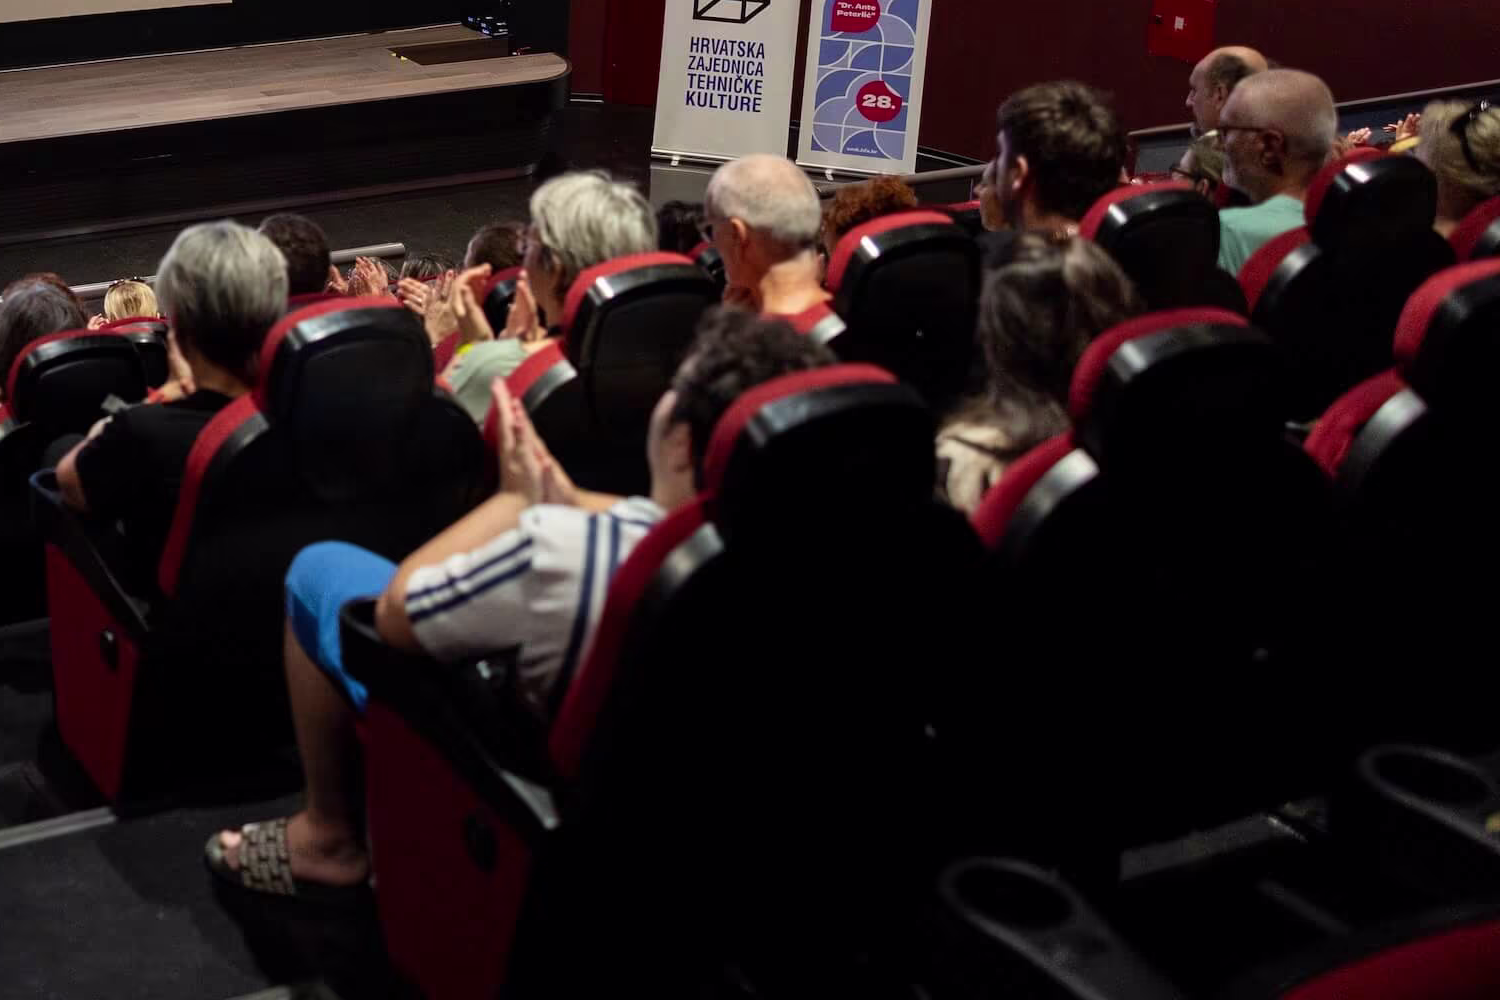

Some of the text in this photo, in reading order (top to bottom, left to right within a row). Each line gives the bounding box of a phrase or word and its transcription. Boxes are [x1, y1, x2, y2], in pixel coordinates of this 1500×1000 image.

[854, 3, 876, 11] Ante
[690, 36, 765, 59] HRVATSKA
[688, 55, 764, 77] ZAJEDNICA
[687, 73, 763, 95] TEHNIČKE
[685, 91, 762, 113] KULTURE
[862, 94, 896, 110] 28.
